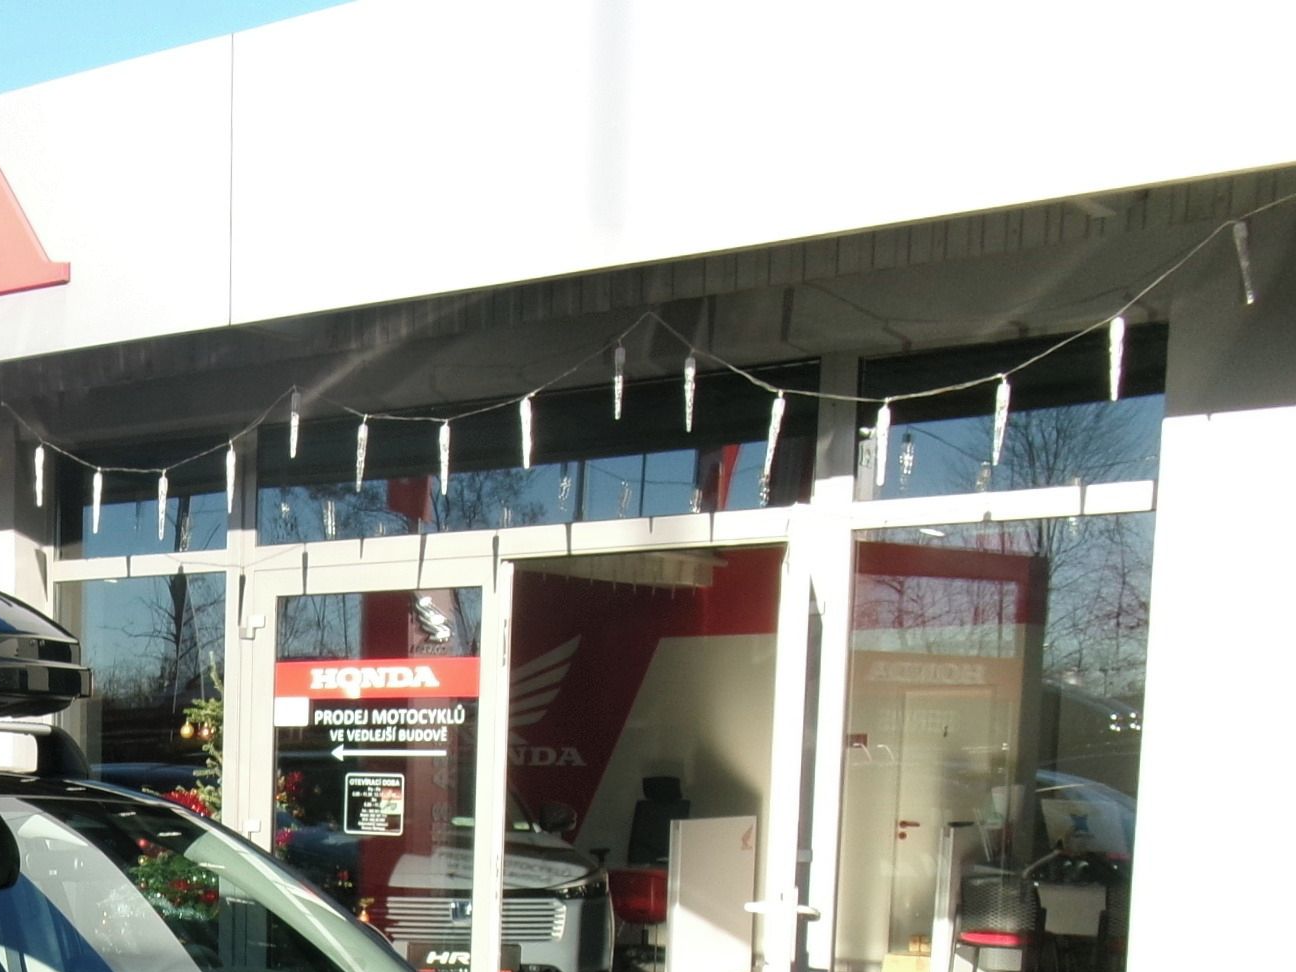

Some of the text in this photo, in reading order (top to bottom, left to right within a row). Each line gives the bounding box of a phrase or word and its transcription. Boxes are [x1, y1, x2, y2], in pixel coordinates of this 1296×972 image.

[310, 666, 440, 690] HONDA
[314, 704, 465, 726] PRODEJ MOTOCYKLŮ
[330, 726, 447, 742] VE VEDLEJŠÍ BUDOVĚ
[508, 746, 587, 766] NDA
